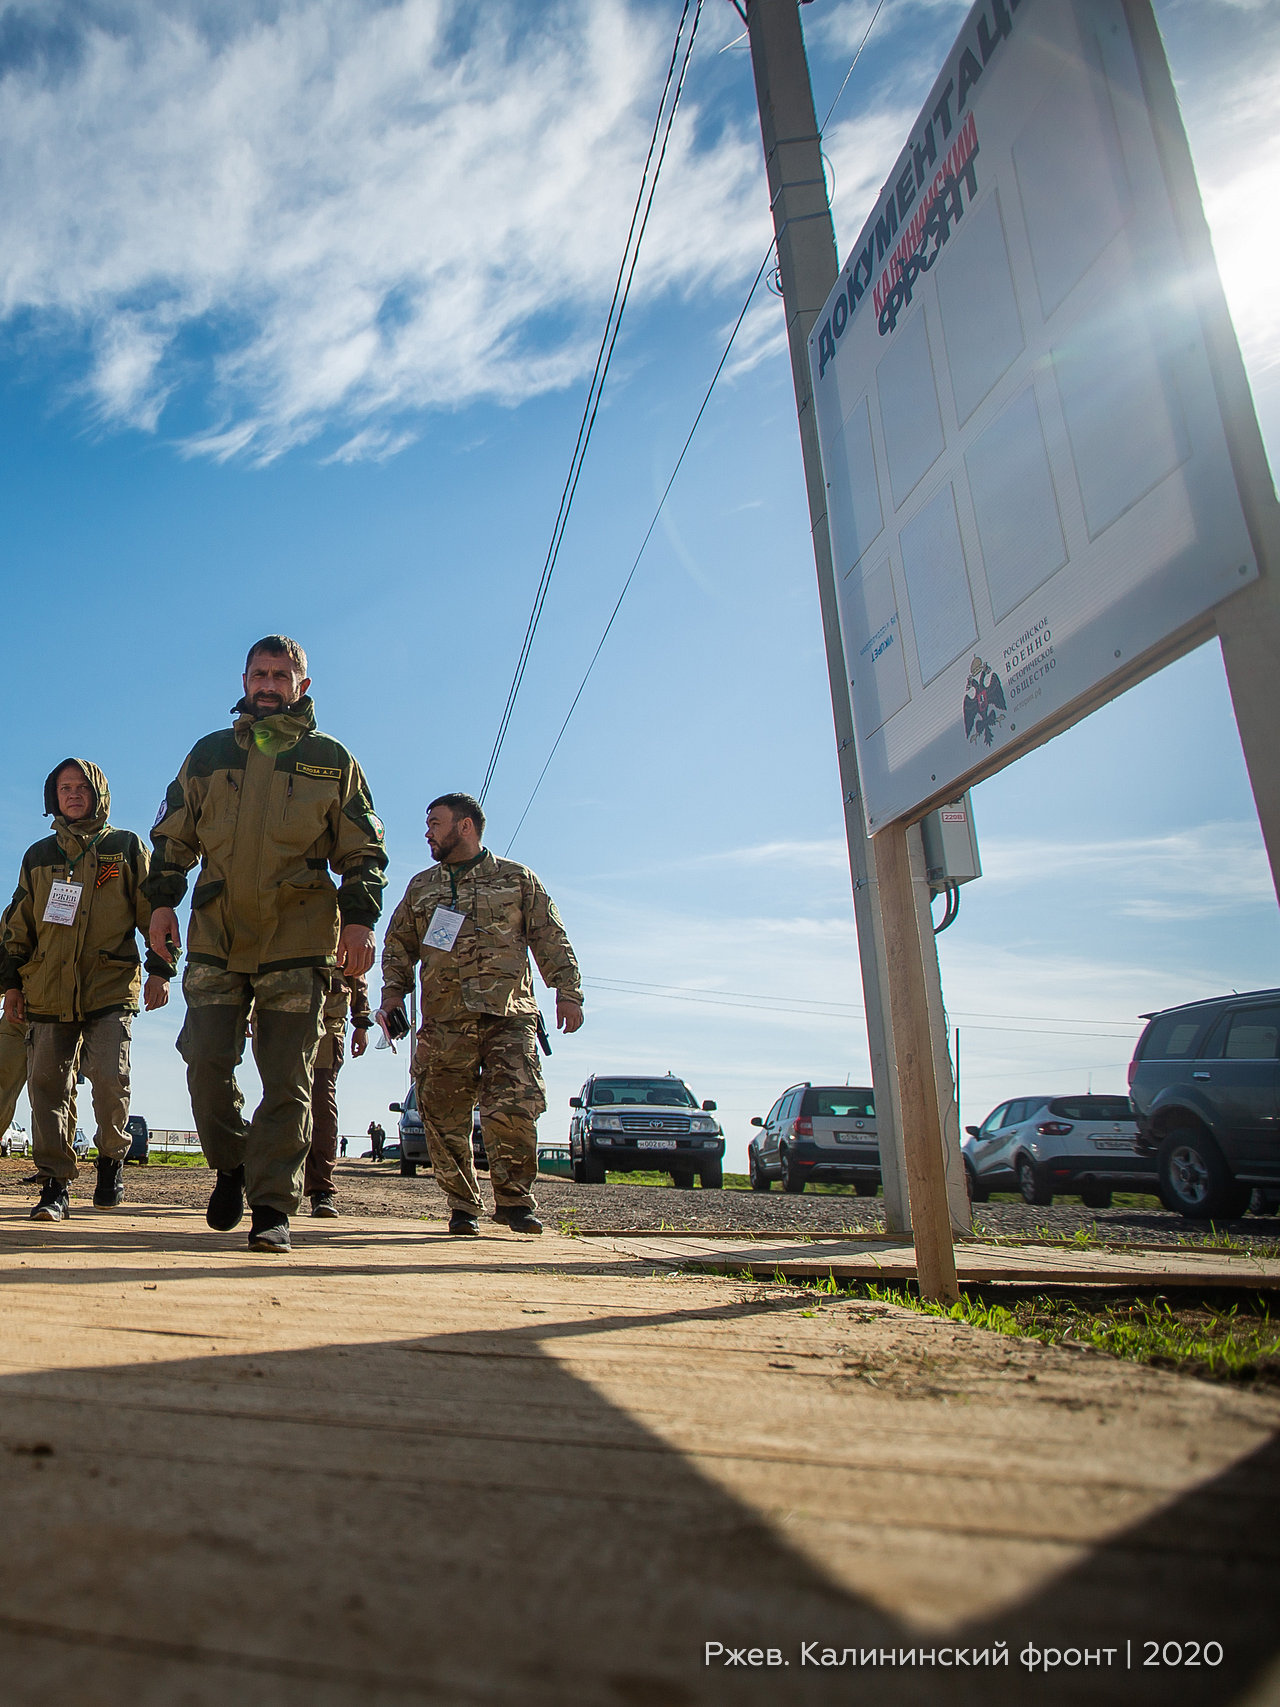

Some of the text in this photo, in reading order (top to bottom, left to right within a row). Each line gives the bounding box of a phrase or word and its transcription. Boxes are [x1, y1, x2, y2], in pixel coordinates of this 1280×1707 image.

[818, 0, 1021, 380] ДОКУМЕНТАЦ
[872, 110, 979, 319] КАЛИНИНСКИЙ
[877, 141, 981, 337] ФРОНТ
[1002, 616, 1049, 659] РОССИЙСКОЕ
[1005, 629, 1052, 673] ВОЕННО
[1007, 645, 1055, 686] ИСТОРИЧЕСКОЕ
[1009, 658, 1057, 699] ОБЩЕСТВО
[52, 892, 77, 902] РЖЕВ
